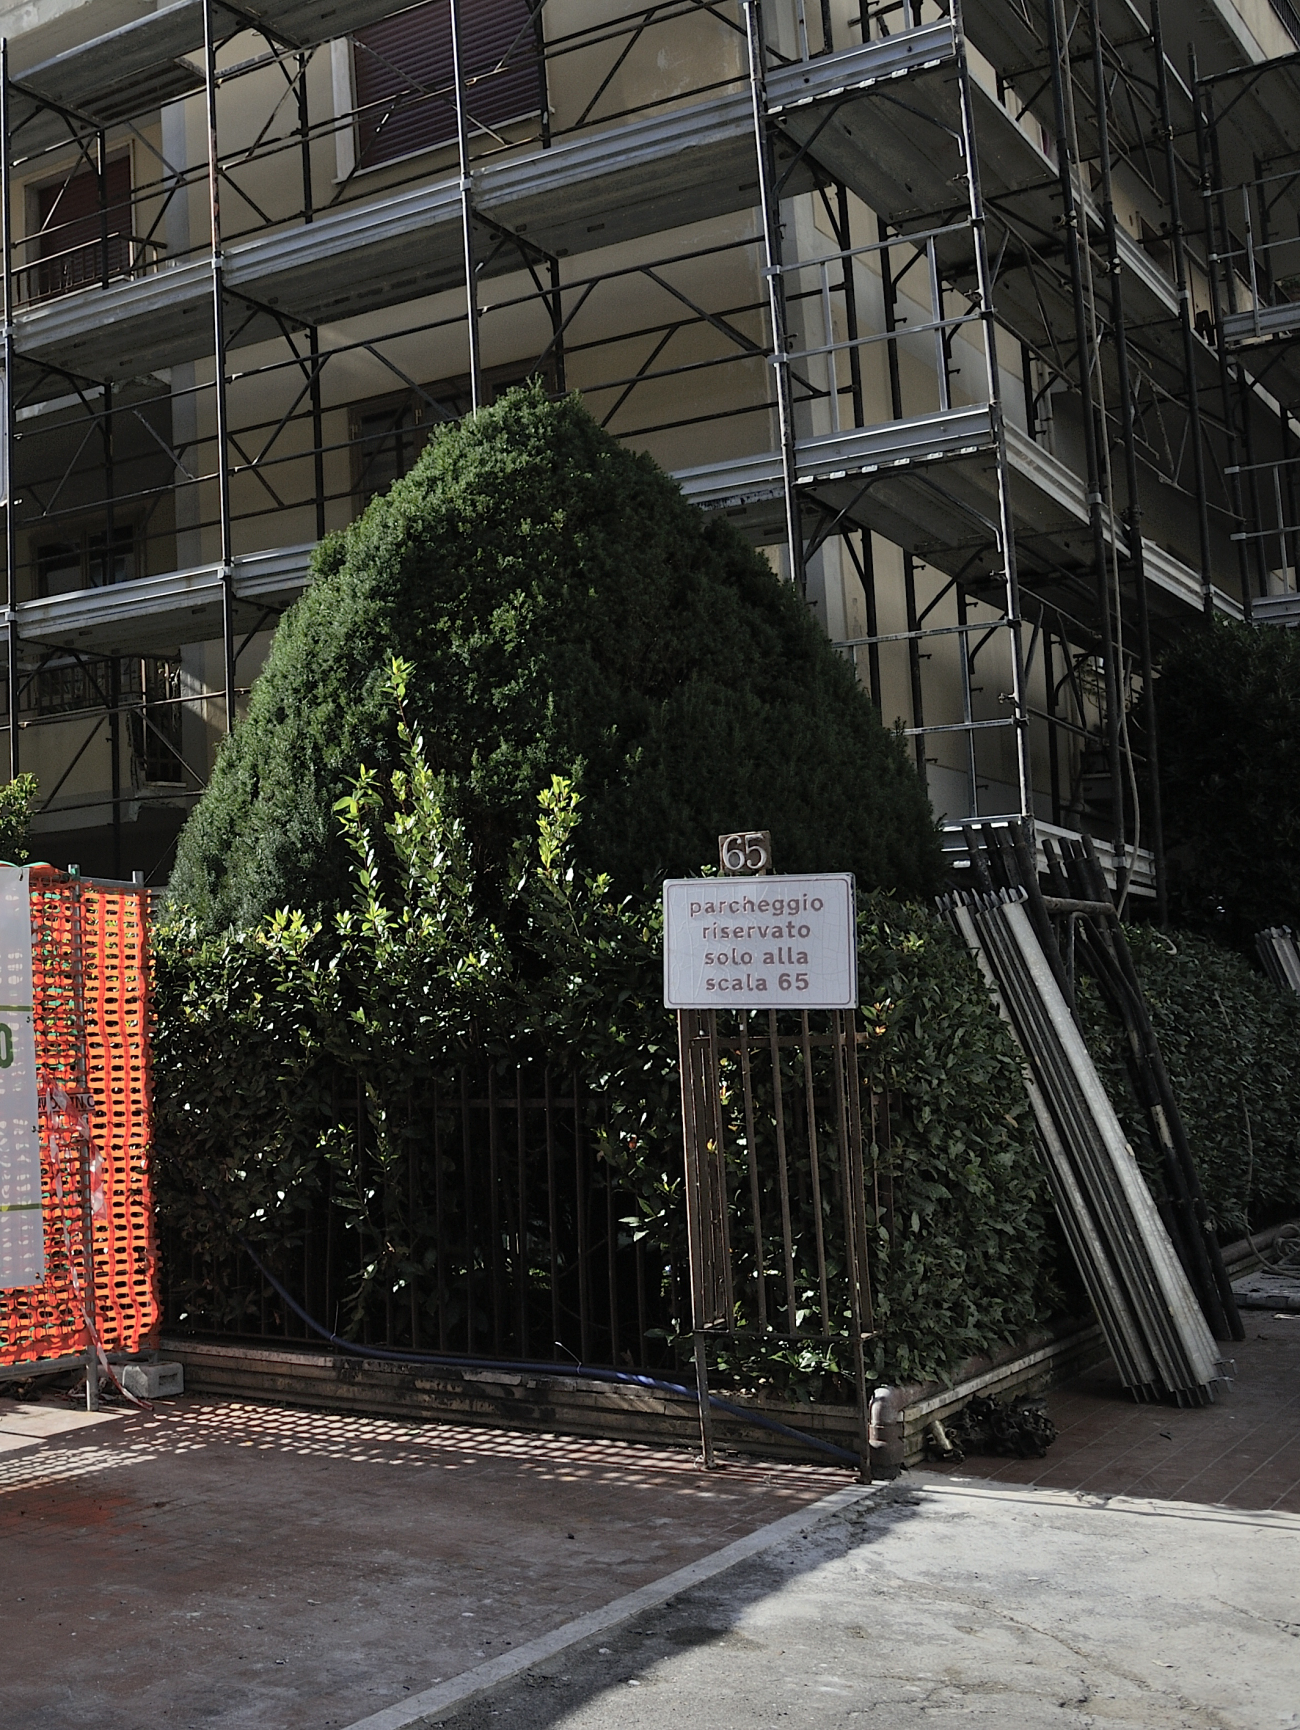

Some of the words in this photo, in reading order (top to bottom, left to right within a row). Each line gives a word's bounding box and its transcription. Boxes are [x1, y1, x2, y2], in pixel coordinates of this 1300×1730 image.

[722, 834, 767, 871] 65
[690, 893, 824, 918] parcheggio
[702, 921, 811, 939] riservato
[704, 948, 753, 965] solo
[763, 947, 809, 965] alla
[706, 973, 768, 992] scala
[778, 973, 810, 992] 65
